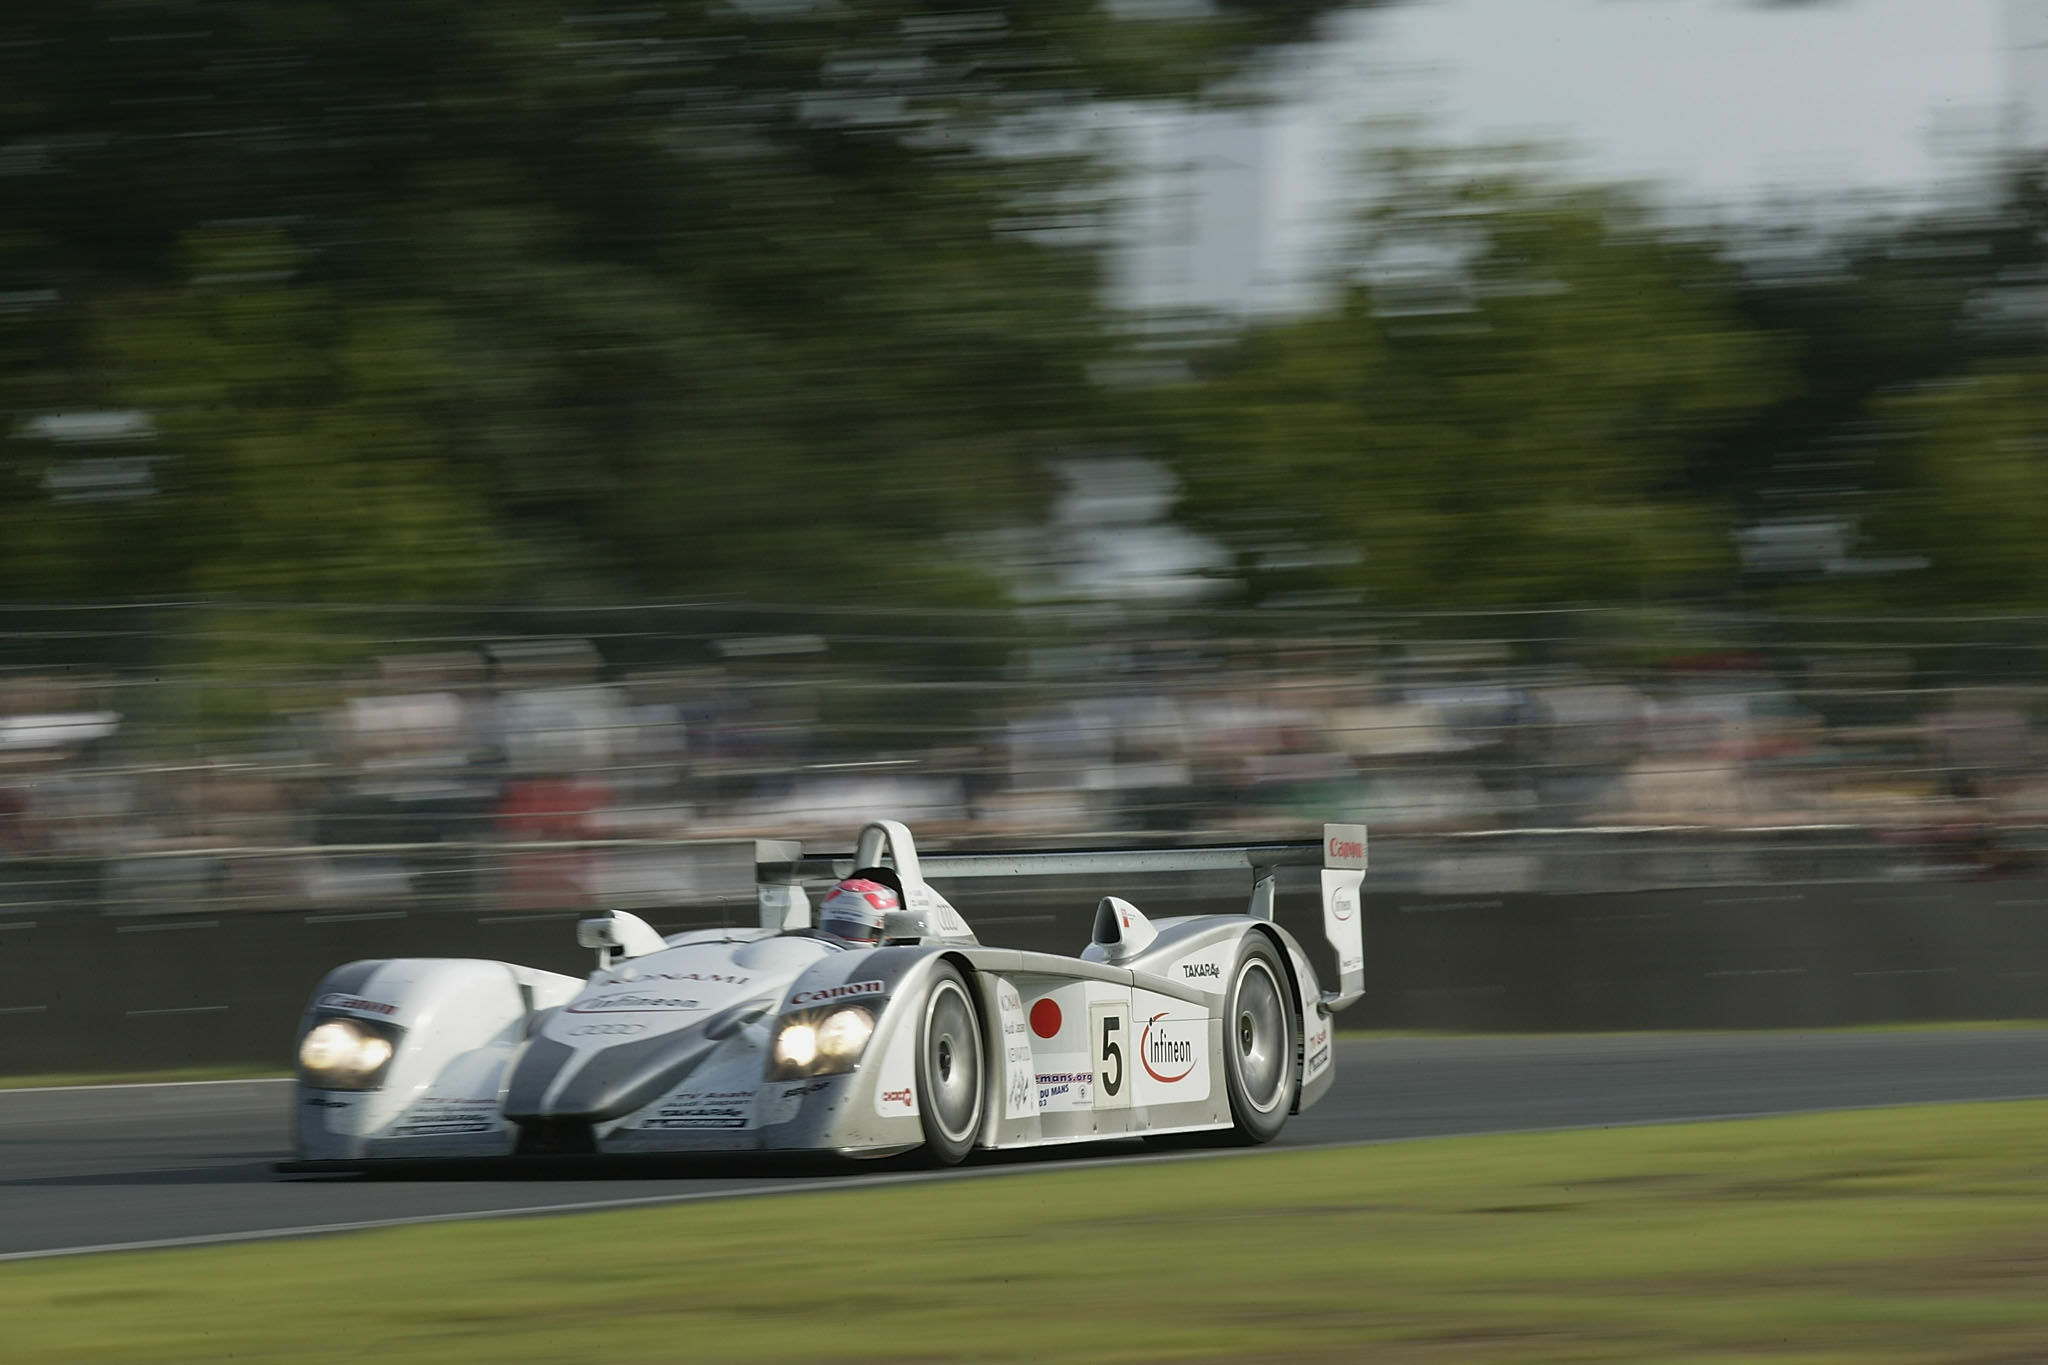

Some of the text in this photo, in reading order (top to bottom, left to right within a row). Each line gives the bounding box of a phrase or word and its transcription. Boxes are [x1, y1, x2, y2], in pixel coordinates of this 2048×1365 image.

[791, 982, 880, 1004] Canon
[1102, 1016, 1122, 1097] 5
[1150, 1028, 1191, 1063] Infineon
[1040, 1084, 1069, 1098] DU MANS
